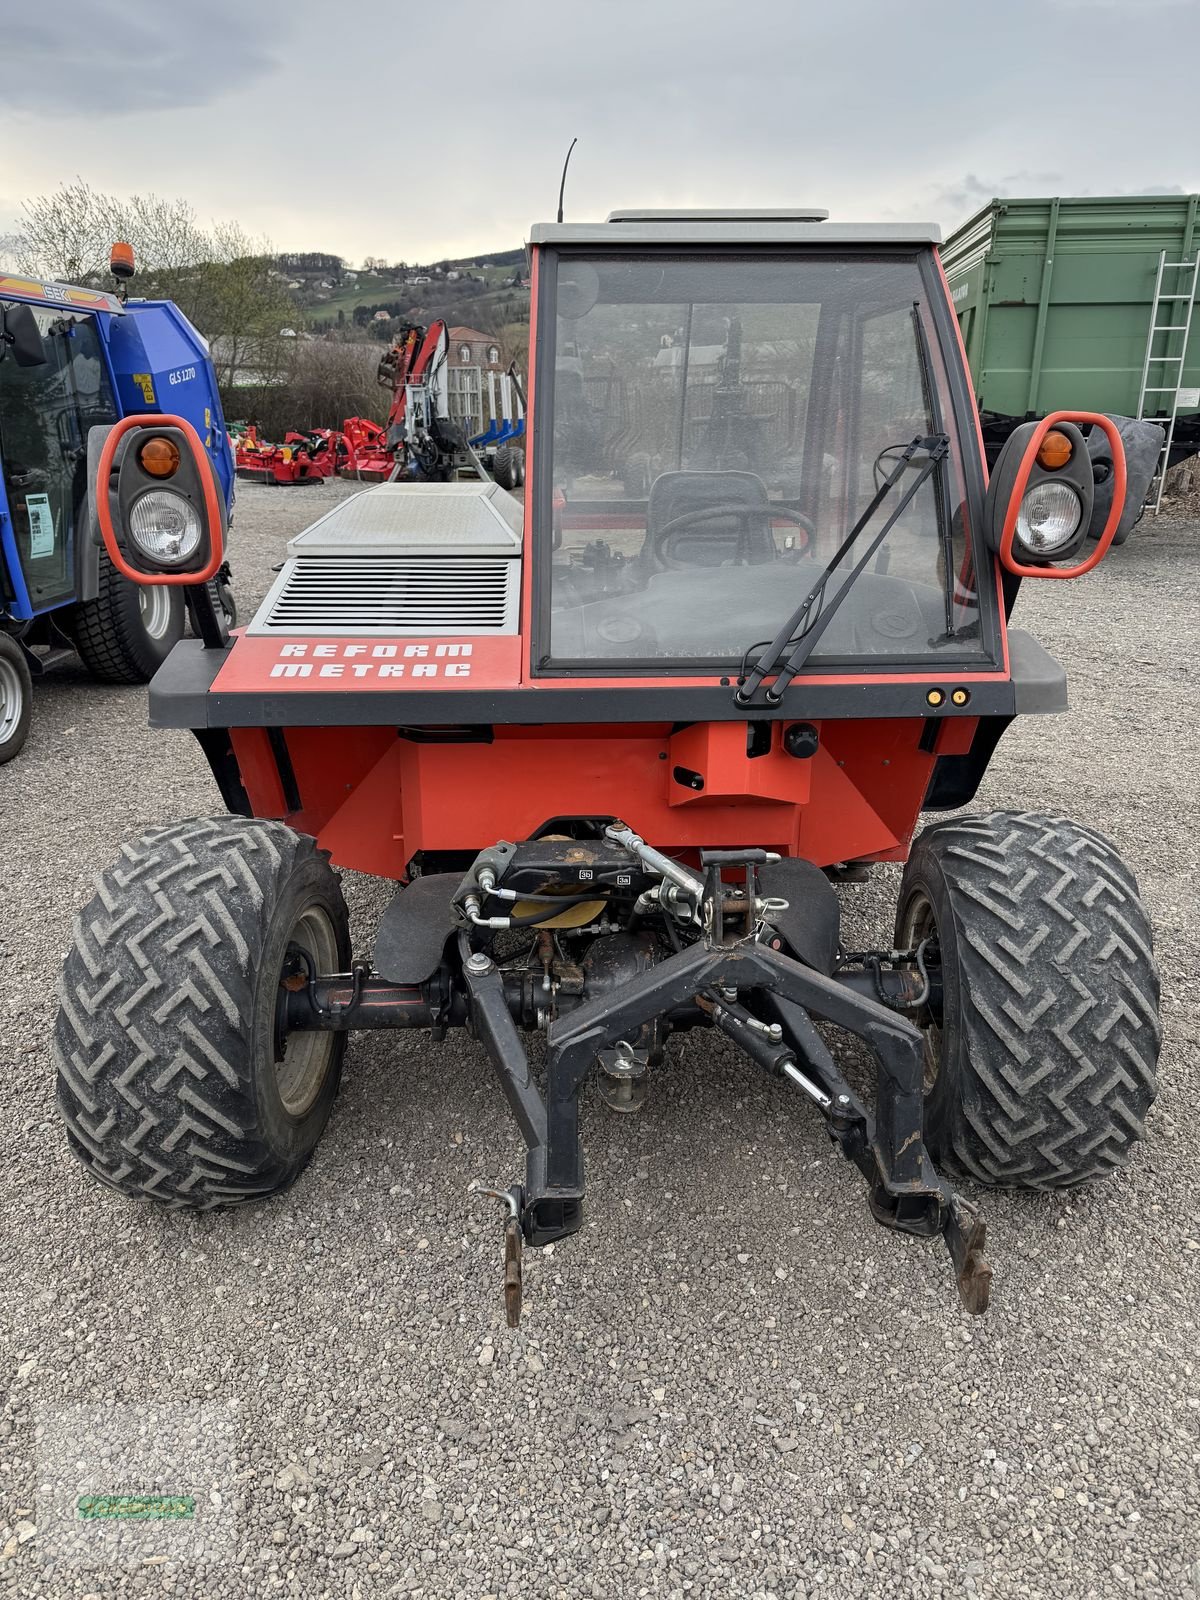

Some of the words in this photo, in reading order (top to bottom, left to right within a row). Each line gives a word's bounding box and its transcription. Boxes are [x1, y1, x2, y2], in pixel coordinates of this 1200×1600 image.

[169, 371, 182, 385] GLS
[181, 367, 196, 382] 1270
[279, 644, 473, 657] REFORM
[269, 664, 471, 677] METRAC
